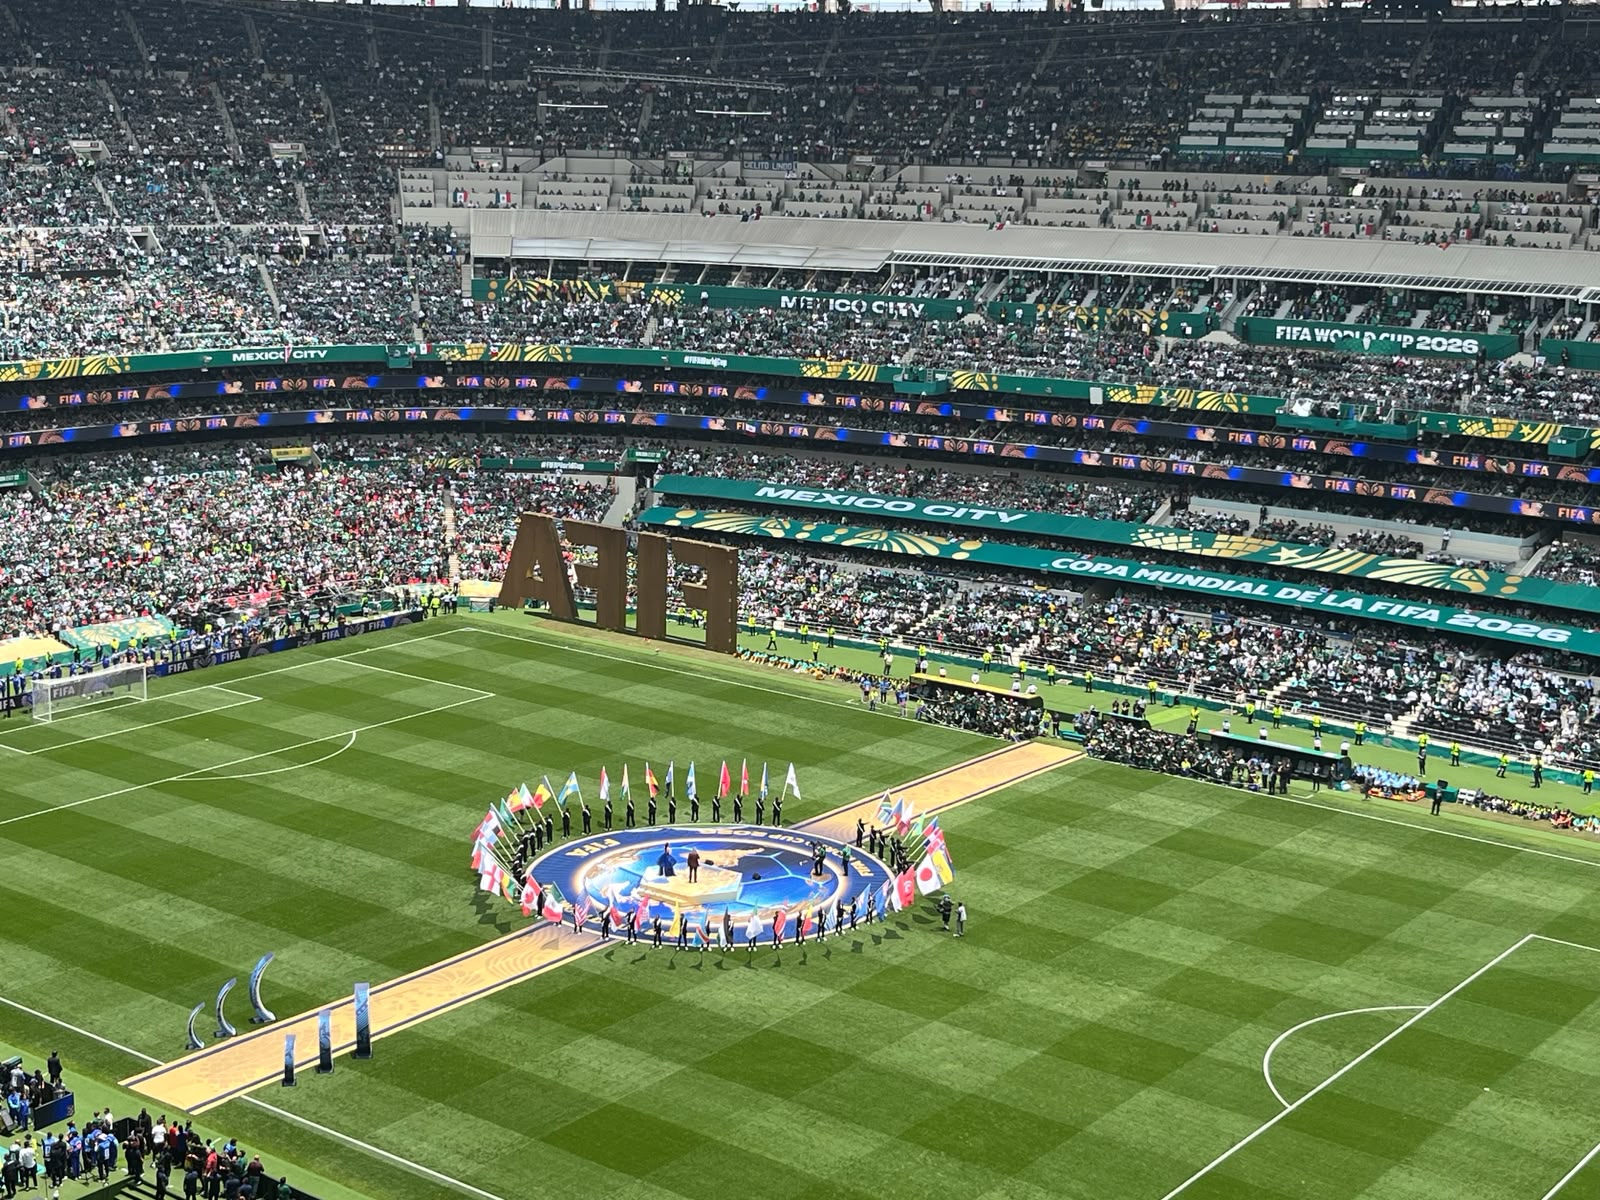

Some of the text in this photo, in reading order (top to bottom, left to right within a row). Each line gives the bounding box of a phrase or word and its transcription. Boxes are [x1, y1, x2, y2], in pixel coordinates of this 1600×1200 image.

[872, 301, 925, 317] CITY
[1276, 325, 1312, 342] FIFA
[1416, 336, 1479, 354] 2026
[232, 350, 328, 362] MEXICO CITY
[255, 380, 277, 391] FIFA
[313, 378, 336, 388] FIFA
[515, 378, 537, 388] FIFA
[653, 383, 675, 393] FIFA
[117, 390, 139, 400] FIFA
[708, 386, 728, 397] FIFA
[59, 394, 82, 405] FIFA
[835, 396, 856, 407] FIFA
[889, 401, 911, 412] FIFA
[346, 411, 369, 421] FIFA
[405, 410, 428, 420] FIFA
[547, 411, 569, 421] FIFA
[604, 413, 626, 423] FIFA
[1024, 412, 1047, 423] FIFA
[150, 421, 172, 432] FIFA
[206, 417, 228, 427] FIFA
[736, 421, 756, 433] FI
[1082, 417, 1105, 429] FIFA
[788, 426, 809, 437] FIFA
[9, 435, 32, 446] FIFA
[918, 437, 939, 449] FIFA
[1228, 432, 1253, 444] FIFA
[973, 442, 995, 454] FIFA
[1292, 438, 1317, 450] FIFA
[1112, 456, 1135, 468] FIFA
[1172, 463, 1196, 474] FIFA
[1522, 463, 1550, 476] FIFA
[148, 472, 199, 484] EXIO
[1324, 479, 1350, 491] FIFA
[1390, 487, 1416, 500] FIFA
[754, 486, 1029, 524] MEXICO CITY
[1558, 507, 1586, 520] FIFA
[1051, 557, 1572, 643] COPA MUNDIAL DE LA FIFA 2026
[368, 620, 387, 631] FIFA
[322, 630, 340, 640] FIFA
[221, 650, 241, 662] FIFA
[167, 661, 189, 674] FIFA
[53, 685, 75, 699] FIFA
[564, 838, 621, 857] FIFA
